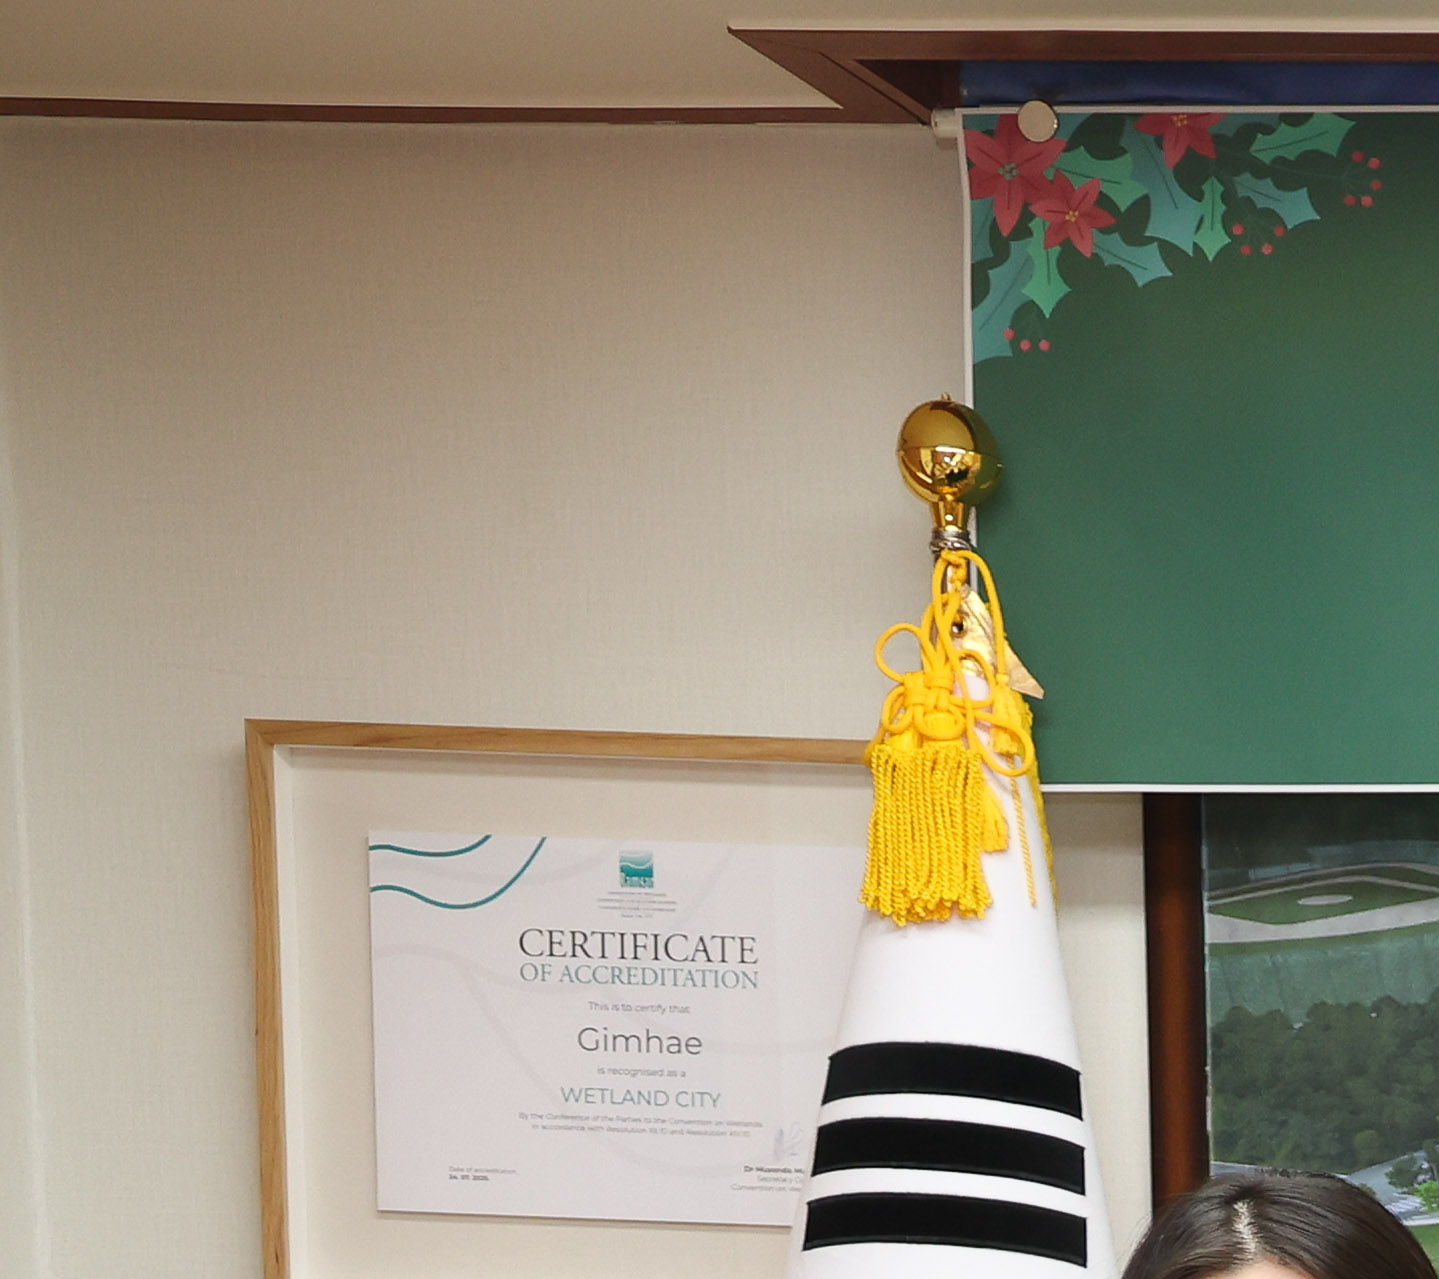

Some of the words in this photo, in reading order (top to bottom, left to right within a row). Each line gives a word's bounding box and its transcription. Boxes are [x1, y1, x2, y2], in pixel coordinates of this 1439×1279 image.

[519, 927, 759, 965] CERTIFICATE
[519, 963, 551, 982] OF
[558, 965, 759, 989] ACCREDITATION
[577, 1026, 703, 1055] Gimhae
[561, 1086, 669, 1107] WETLAND
[675, 1091, 721, 1109] CITY
